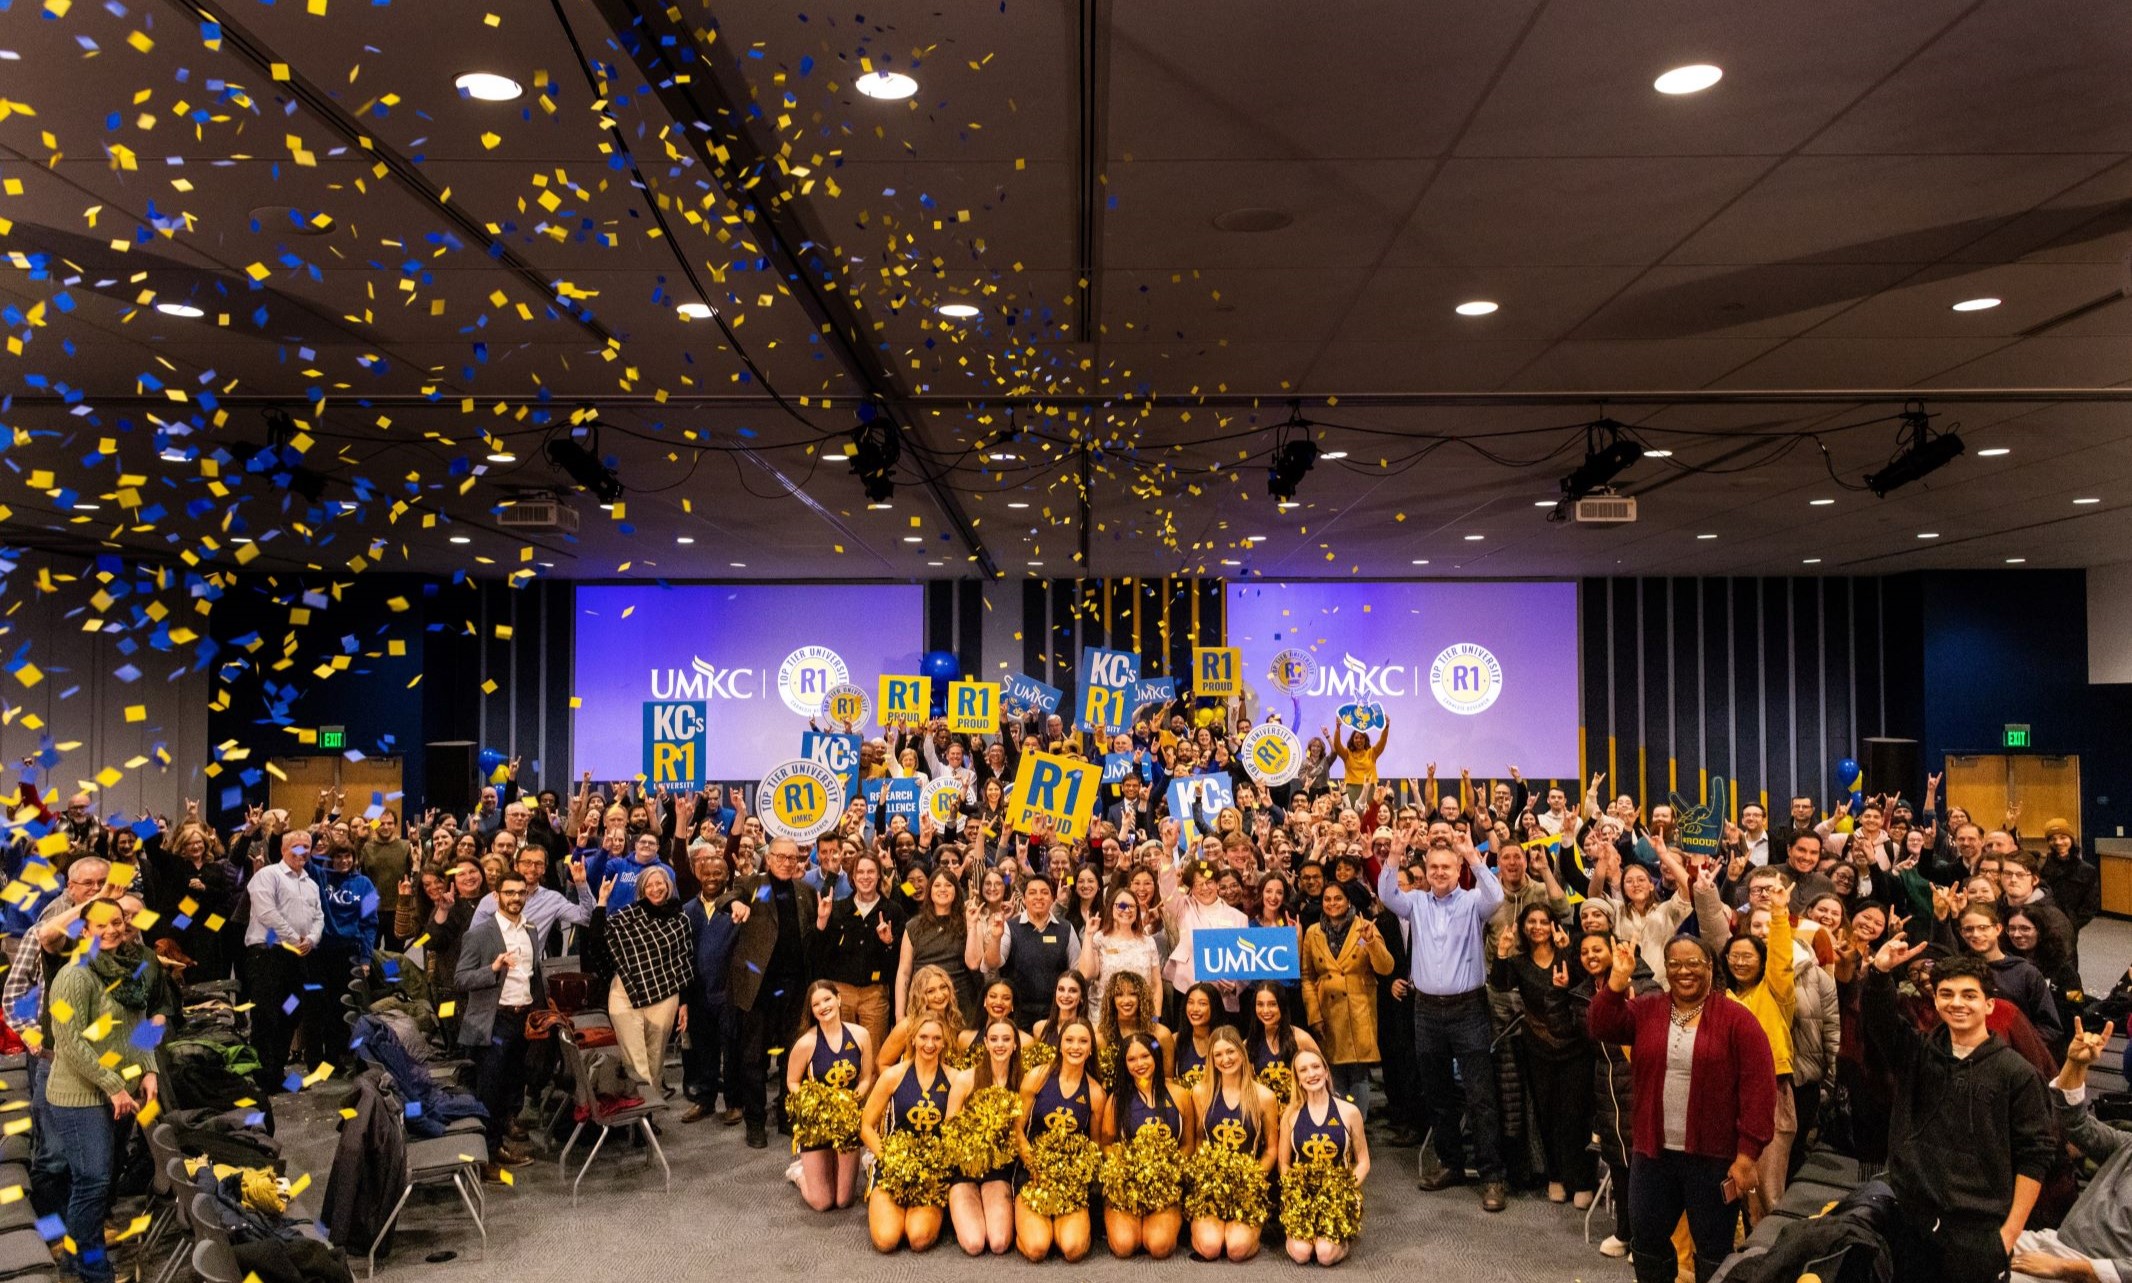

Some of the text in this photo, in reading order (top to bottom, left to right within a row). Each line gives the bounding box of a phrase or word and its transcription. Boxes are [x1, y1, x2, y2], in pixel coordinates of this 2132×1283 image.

[651, 655, 752, 699] UMKC
[780, 668, 789, 686] TOP
[786, 650, 806, 667] TIER
[1090, 652, 1136, 688] KC's
[1202, 652, 1231, 680] R1
[1432, 645, 1500, 684] TOP TIER UNIVERSITY
[1453, 665, 1479, 691] R1
[801, 668, 826, 694] R1
[888, 680, 920, 710] R1
[1202, 682, 1232, 691] PROUD
[838, 698, 854, 715] R1
[958, 687, 989, 717] R1
[1014, 683, 1055, 710] UMKC
[1085, 686, 1125, 726] R1
[653, 704, 705, 740] KC's
[957, 719, 989, 729] PROUD
[325, 732, 342, 747] EXIT
[1245, 727, 1291, 777] TOP TIER UNIVERSITY
[2008, 731, 2025, 746] EXIT
[653, 742, 694, 782] R1
[1257, 739, 1282, 767] R1
[762, 791, 772, 812] TOP
[767, 768, 788, 788] TIER
[791, 764, 838, 803] UNIVERSITY
[784, 782, 816, 814] R1
[870, 791, 913, 802] REEARCH
[928, 782, 942, 794] TIER
[1026, 759, 1084, 816] R1
[791, 814, 814, 825] UMKC
[867, 803, 916, 814] EXLLENCE
[777, 819, 829, 838] CARNEGIE RESEARCH
[1204, 936, 1289, 973] UMKC
